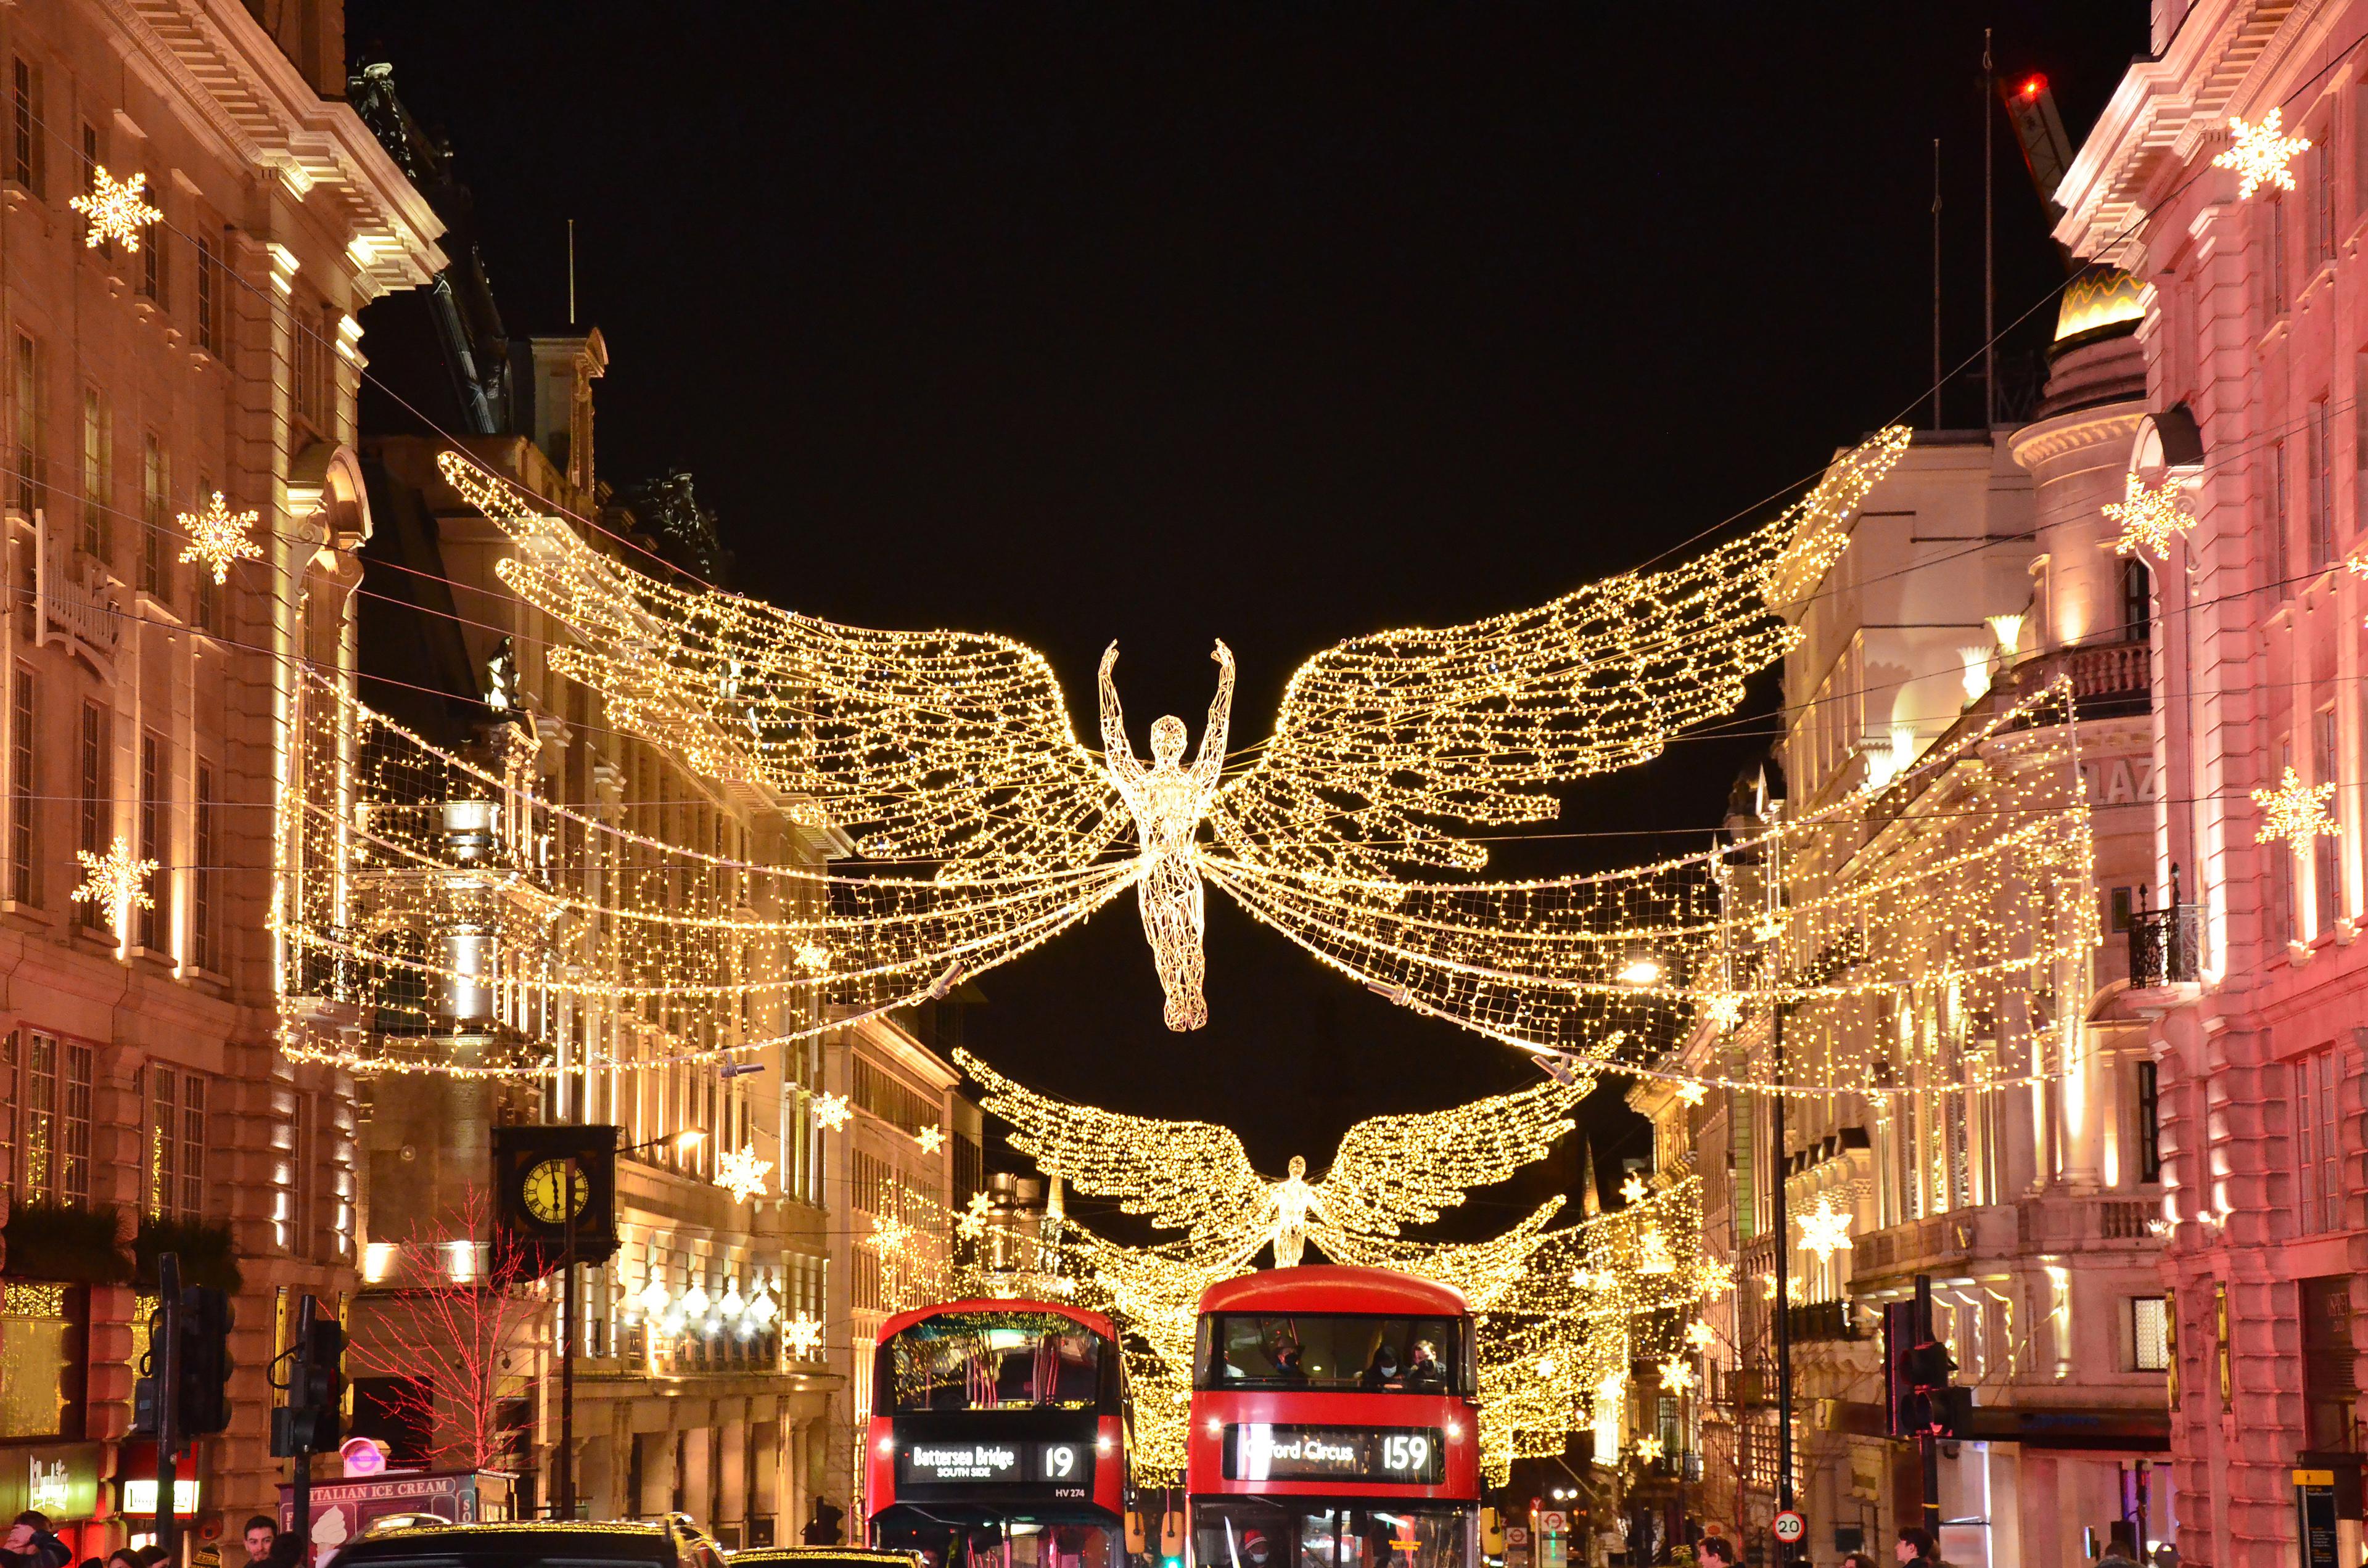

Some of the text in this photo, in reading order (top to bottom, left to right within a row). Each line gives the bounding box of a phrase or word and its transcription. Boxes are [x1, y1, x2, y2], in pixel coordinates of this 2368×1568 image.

[913, 1446, 1014, 1470] Battersea Bridge
[1243, 1440, 1354, 1461] Oford Circus
[1384, 1437, 1428, 1470] 159
[937, 1467, 991, 1477] SOUTH SIDE
[1046, 1447, 1074, 1477] 19
[310, 1480, 447, 1502] ITALIAN ICE CREAM
[1056, 1488, 1085, 1497] HV 274
[1778, 1521, 1799, 1533] 20
